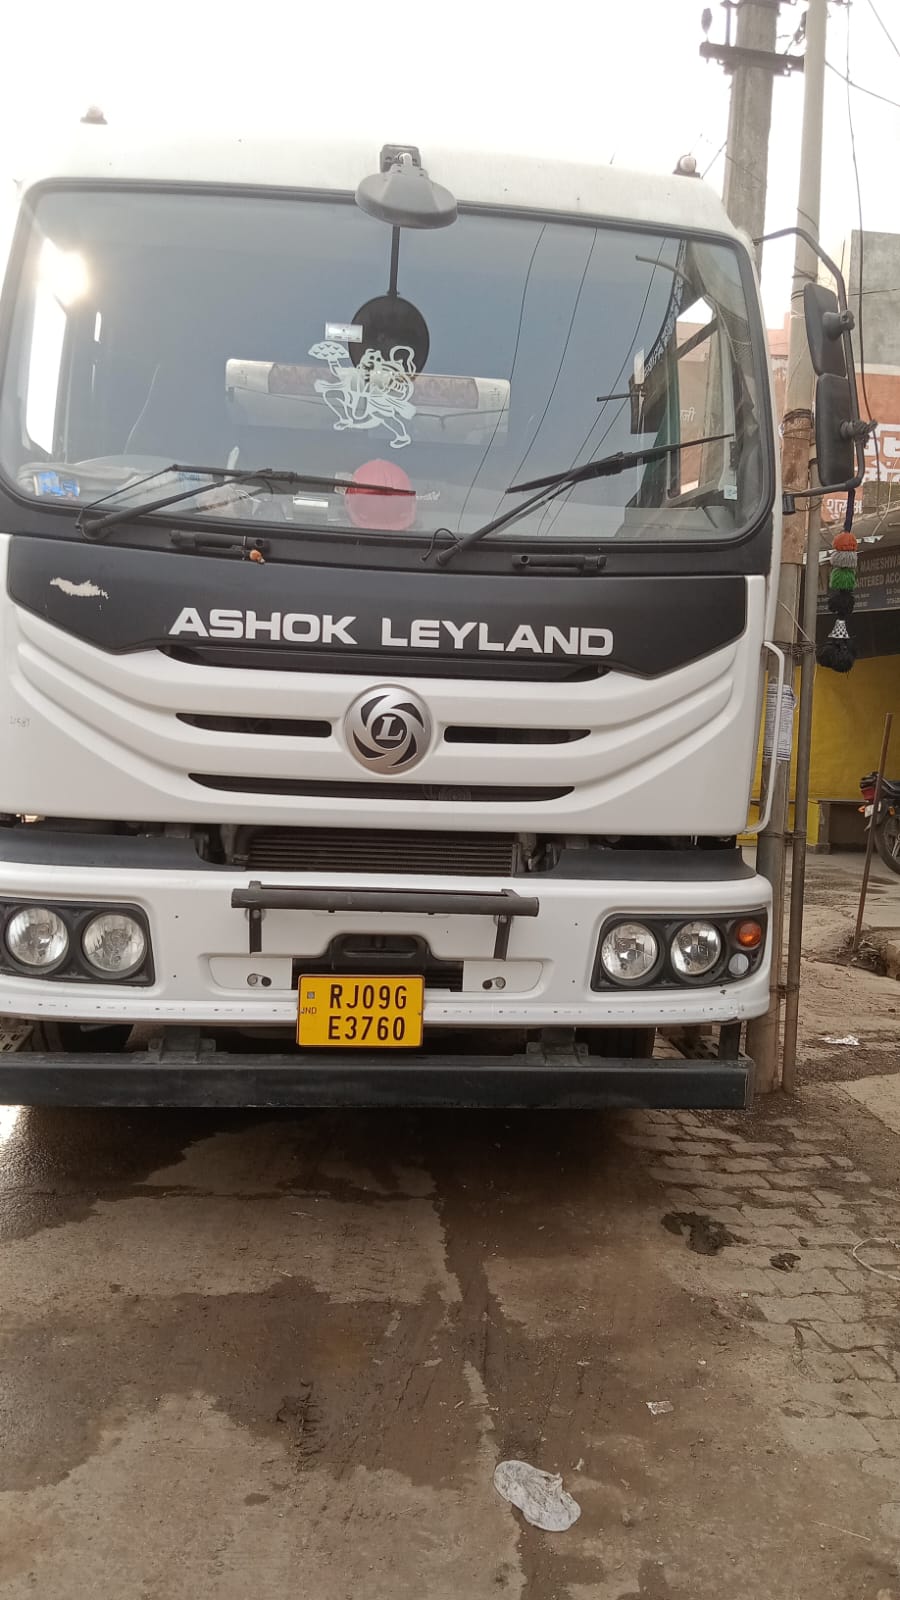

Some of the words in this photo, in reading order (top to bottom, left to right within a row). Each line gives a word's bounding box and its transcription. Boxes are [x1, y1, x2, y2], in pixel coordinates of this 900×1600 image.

[168, 607, 358, 645] ASHOK
[381, 617, 614, 656] LEYLAND
[375, 716, 404, 740] L
[329, 984, 407, 1010] RJ09G
[328, 1015, 406, 1041] E3760
